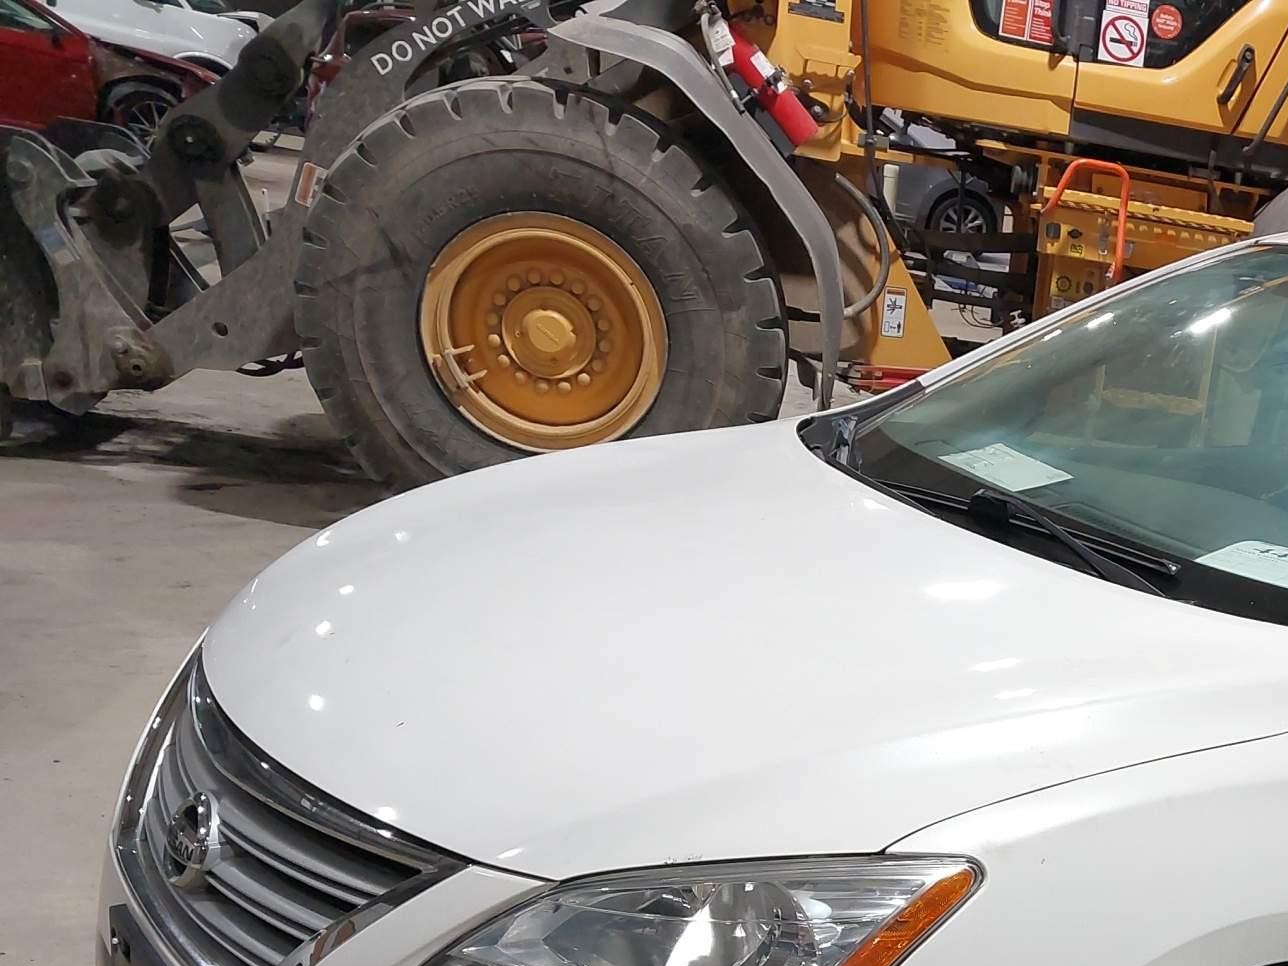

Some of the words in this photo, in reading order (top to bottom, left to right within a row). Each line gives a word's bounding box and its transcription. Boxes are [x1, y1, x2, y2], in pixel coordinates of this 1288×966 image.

[1120, 0, 1147, 11] TIPPING
[370, 40, 413, 75] DO
[412, 6, 467, 51] NOT
